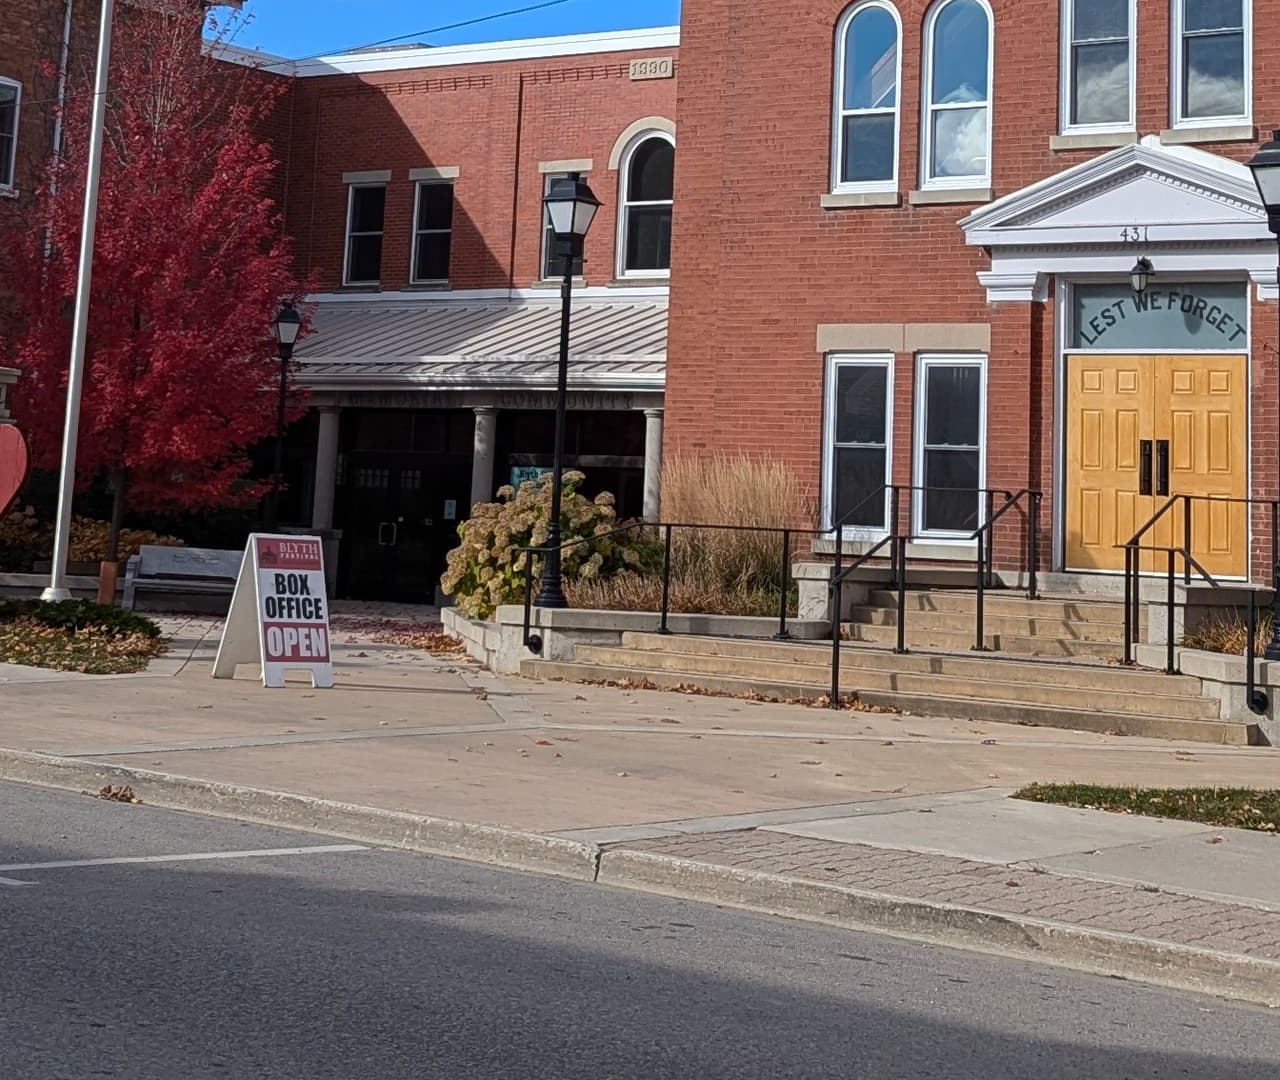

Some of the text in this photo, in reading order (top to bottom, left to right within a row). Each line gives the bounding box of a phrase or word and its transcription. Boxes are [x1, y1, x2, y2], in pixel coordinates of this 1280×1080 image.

[1120, 226, 1149, 242] 431
[1080, 291, 1247, 345] LEST WE FORGET
[279, 542, 318, 554] BLYTH
[274, 573, 311, 596] BOX
[265, 596, 324, 620] OFFICE
[266, 626, 327, 657] OPEN
